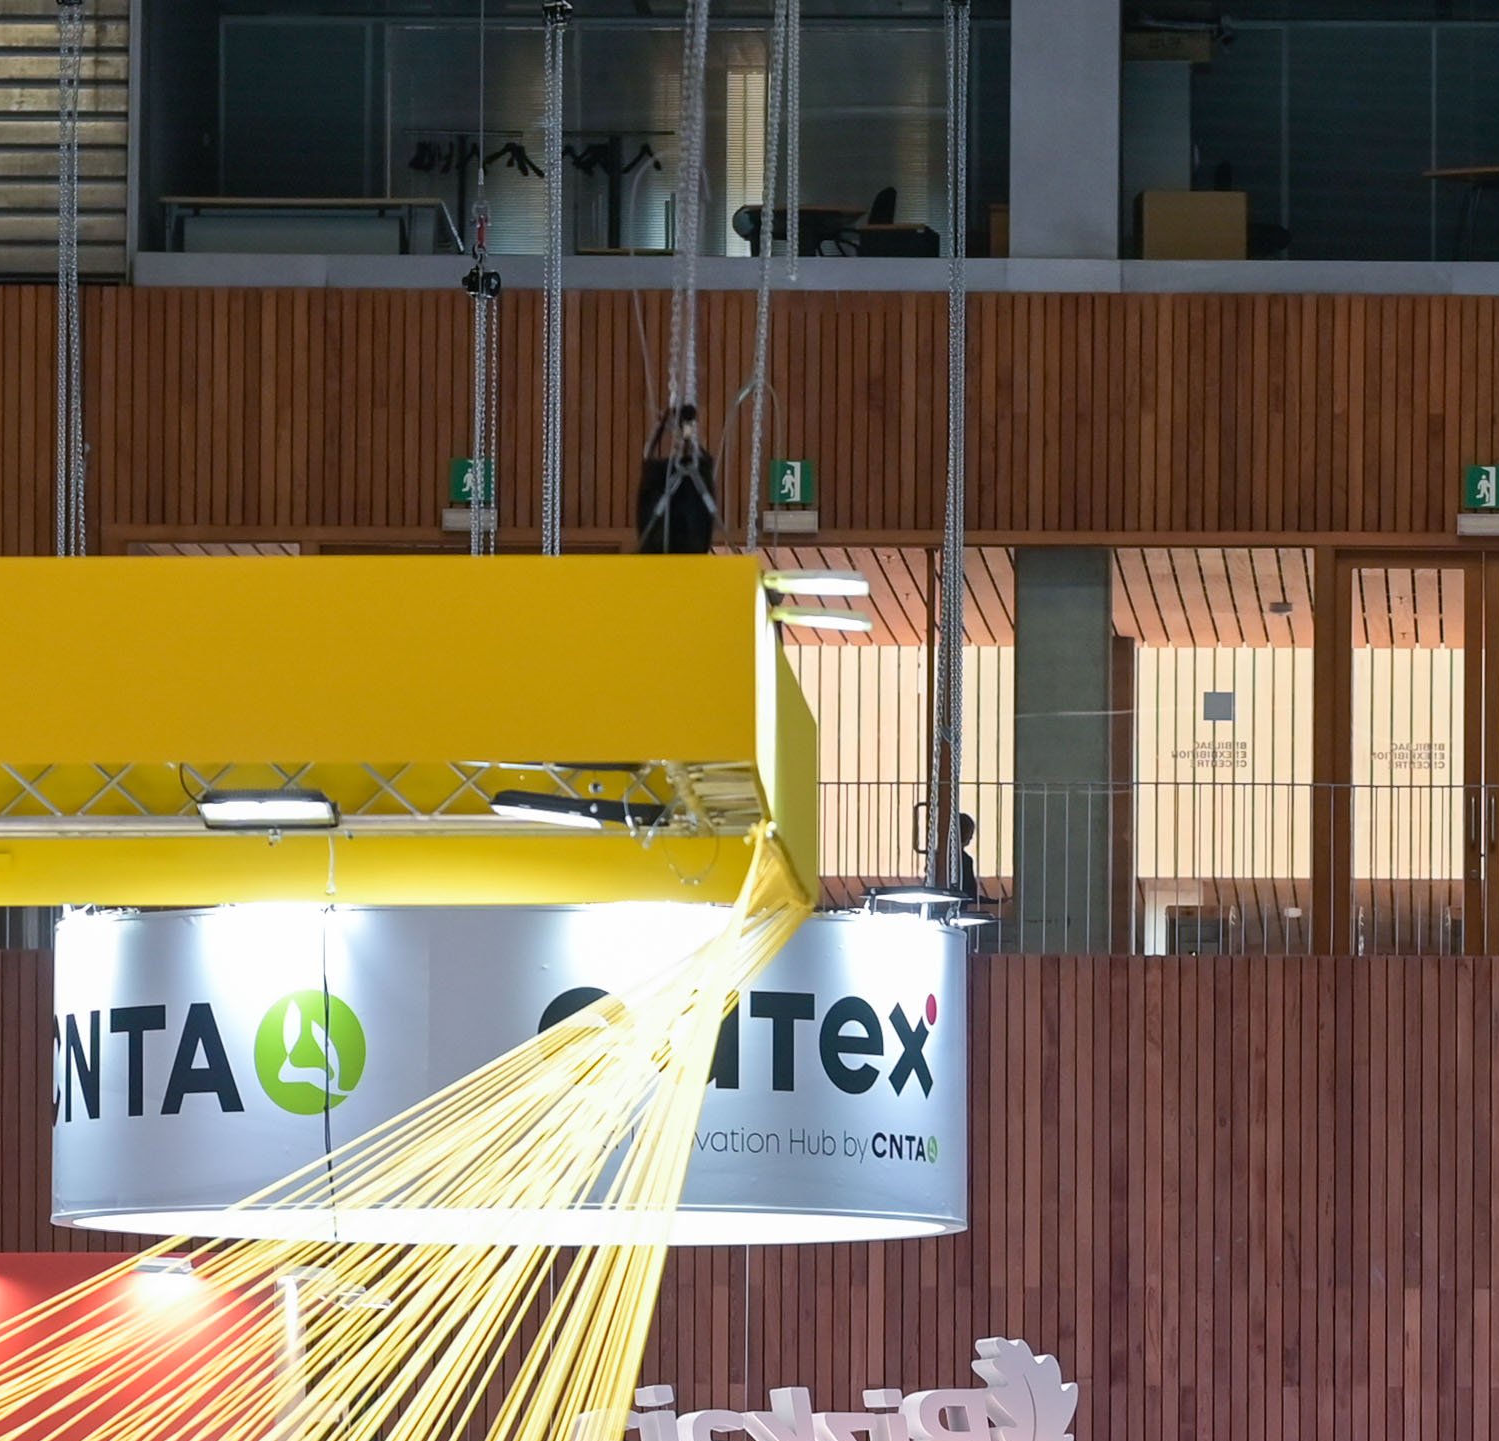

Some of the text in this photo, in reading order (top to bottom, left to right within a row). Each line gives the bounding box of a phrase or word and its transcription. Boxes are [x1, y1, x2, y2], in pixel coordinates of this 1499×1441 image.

[790, 1129, 835, 1156] Hub
[844, 1130, 868, 1163] by
[872, 1132, 926, 1162] CNTA
